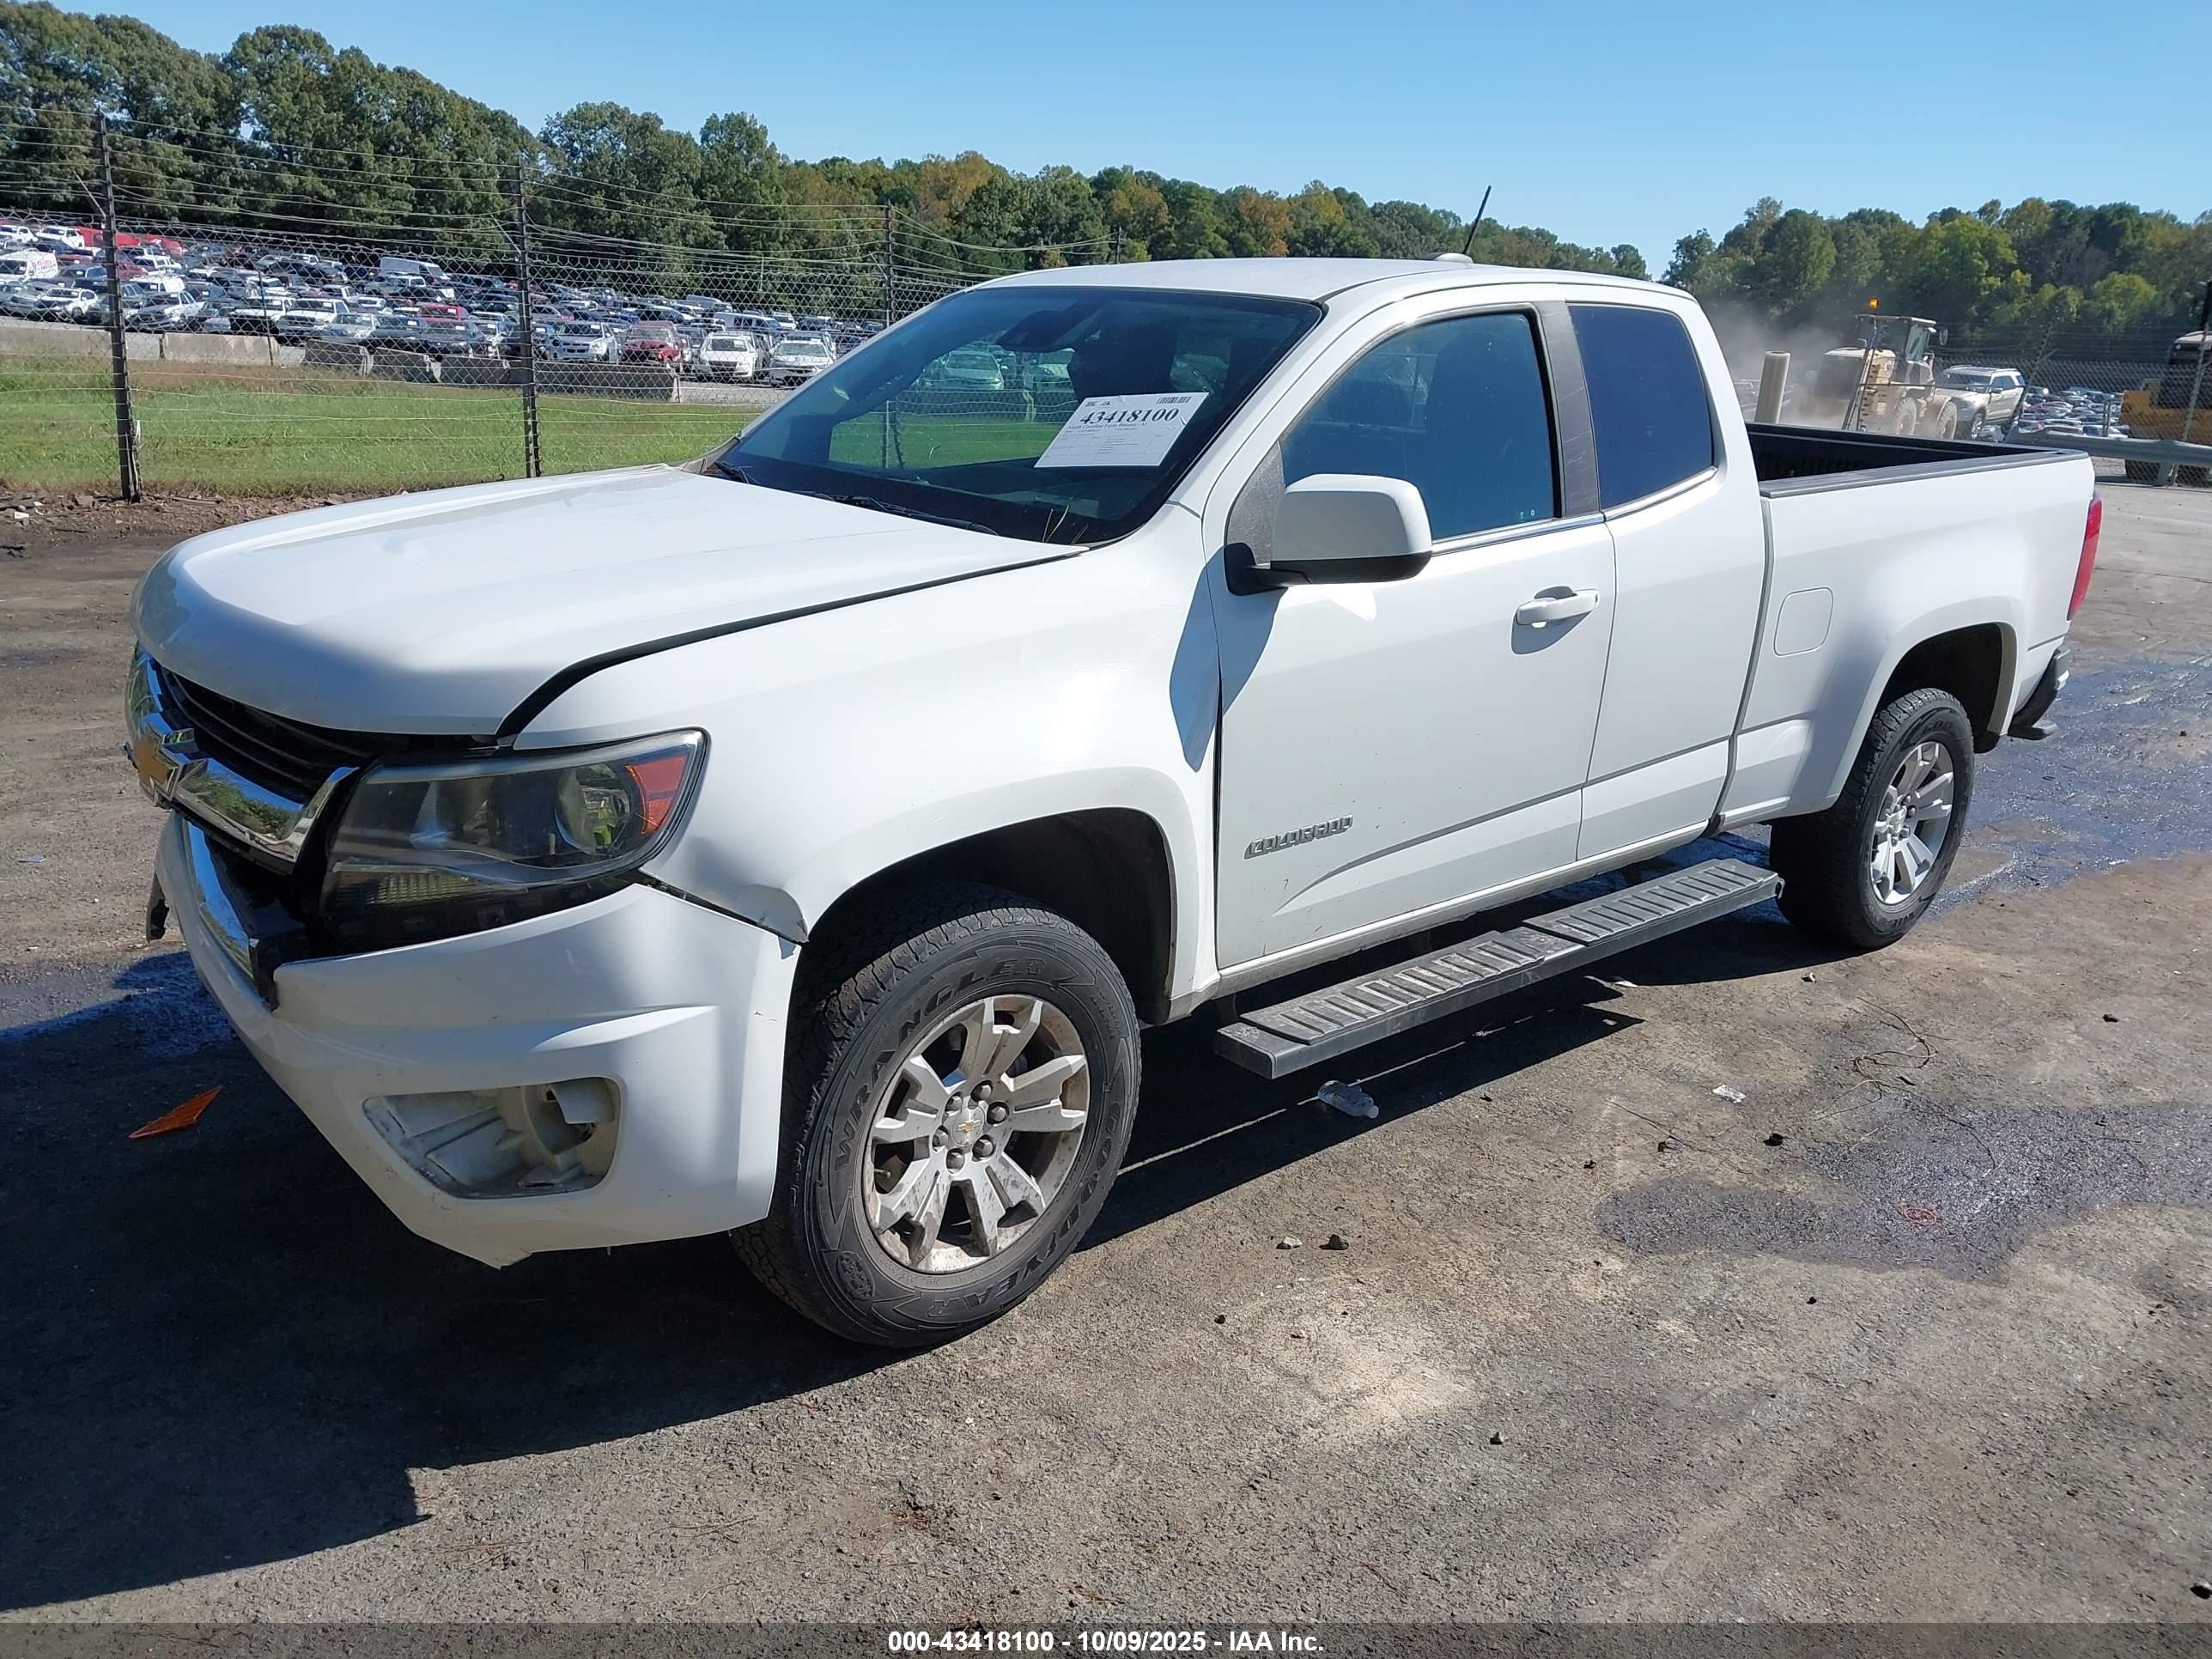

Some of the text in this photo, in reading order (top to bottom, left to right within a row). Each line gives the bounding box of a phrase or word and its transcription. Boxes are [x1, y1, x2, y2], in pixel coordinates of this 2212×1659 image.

[1079, 408, 1179, 424] 43418100
[1243, 815, 1354, 860] COLORADO
[835, 957, 1045, 1171] WRANGLER
[927, 1101, 1122, 1317] GOODYEAR
